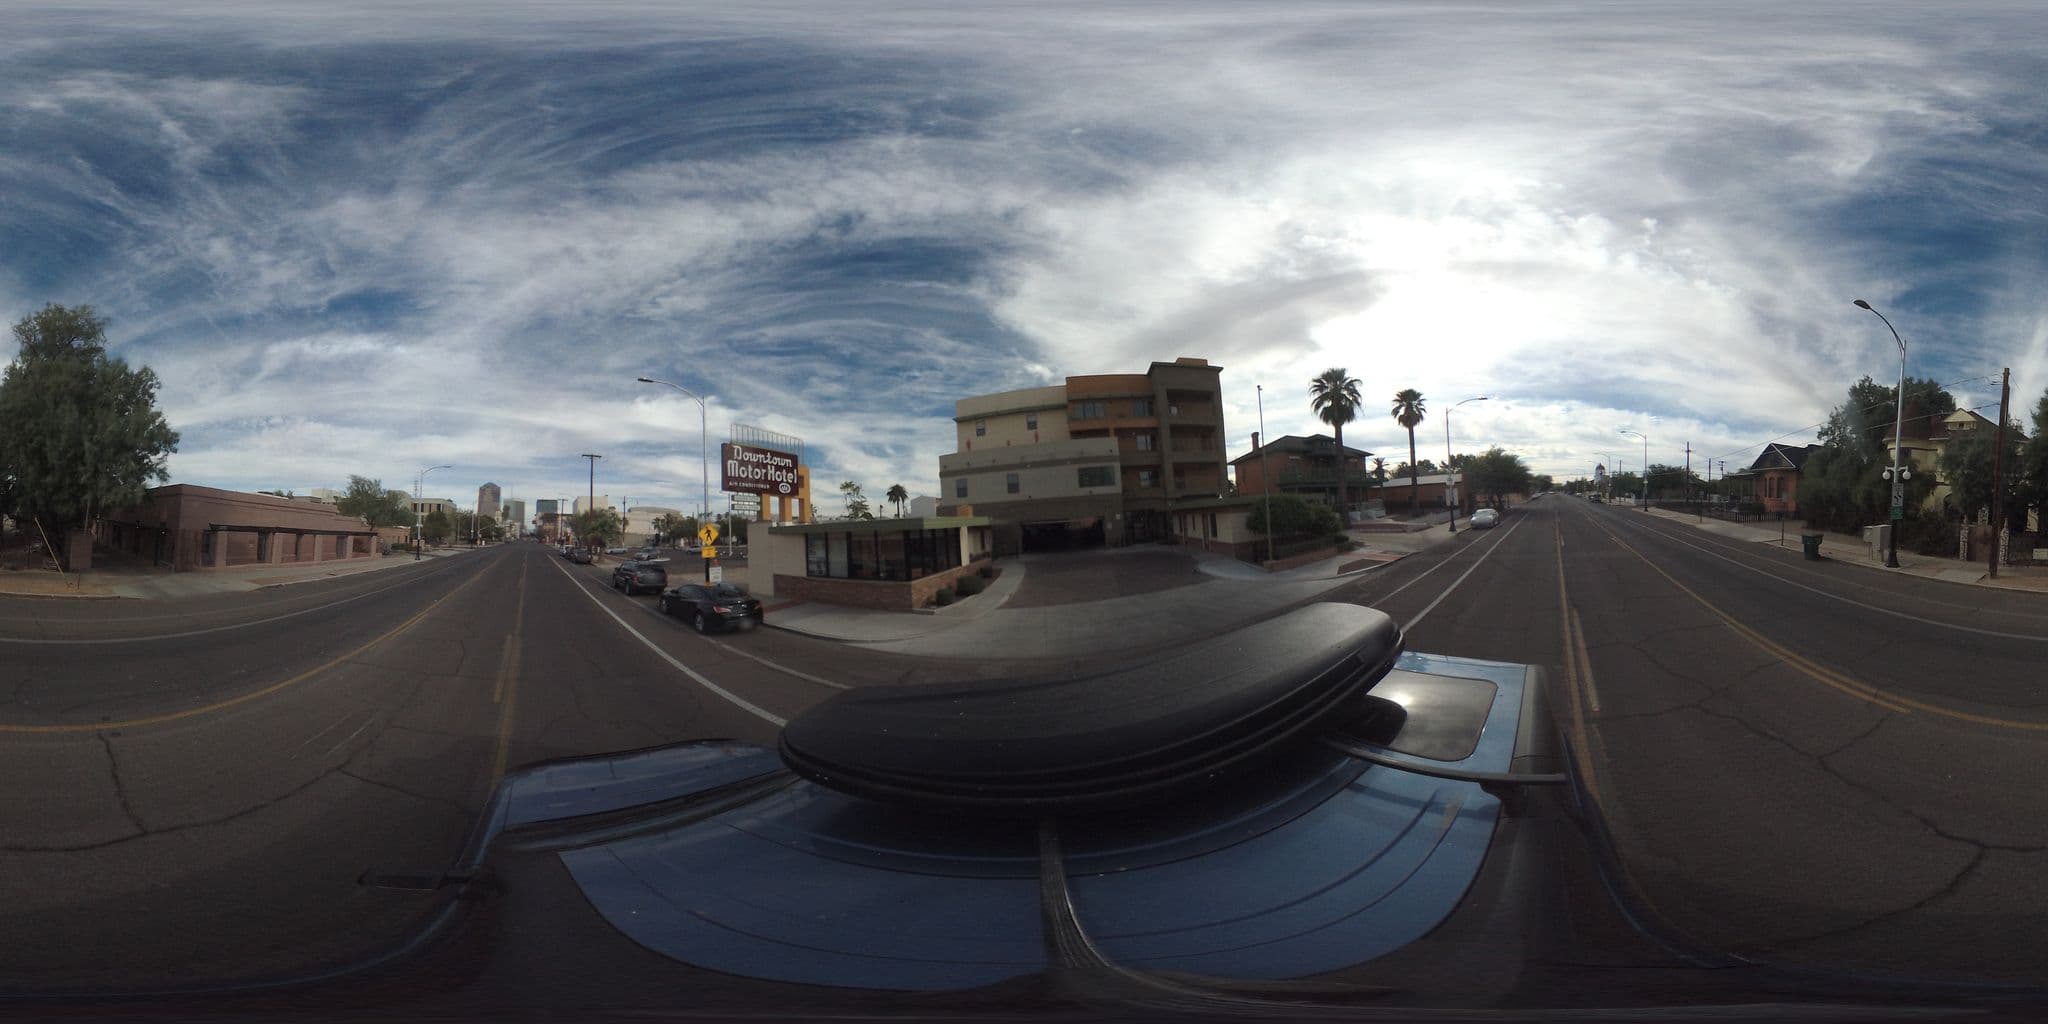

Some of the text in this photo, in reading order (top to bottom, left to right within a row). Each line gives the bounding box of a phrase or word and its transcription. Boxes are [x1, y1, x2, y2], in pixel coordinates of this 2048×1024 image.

[732, 445, 792, 467] Downtown
[727, 460, 797, 484] Motor Hotel
